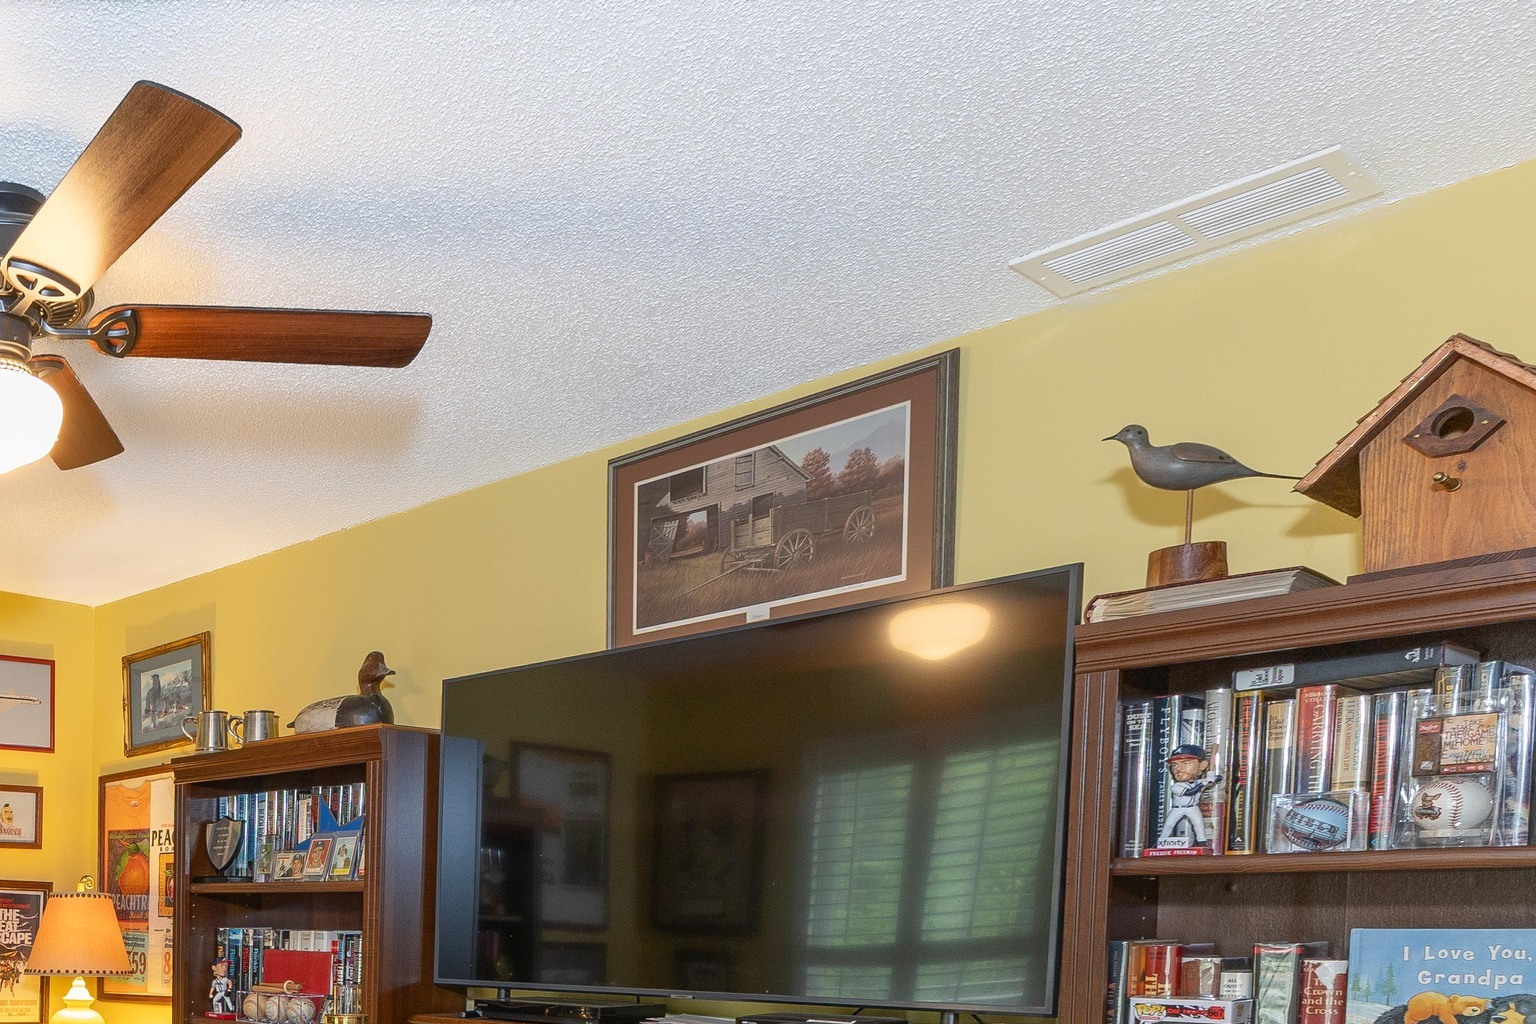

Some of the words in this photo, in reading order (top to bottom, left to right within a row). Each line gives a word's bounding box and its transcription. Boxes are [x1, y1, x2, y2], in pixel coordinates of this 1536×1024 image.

[1158, 707, 1171, 774] FLYBOYS
[1309, 704, 1325, 770] CARRYING
[1239, 759, 1248, 785] DOWN
[1158, 839, 1188, 848] xfinity
[1402, 946, 1410, 960] I
[1424, 946, 1476, 961] Love
[1488, 944, 1532, 962] You,
[1417, 969, 1524, 990] Grandpa
[1107, 982, 1116, 1004] WILD
[1303, 987, 1343, 996] Crown
[1301, 997, 1323, 1006] and
[1135, 1004, 1166, 1016] POP!
[1209, 1009, 1224, 1018] 667
[1306, 1006, 1339, 1015] Cross
